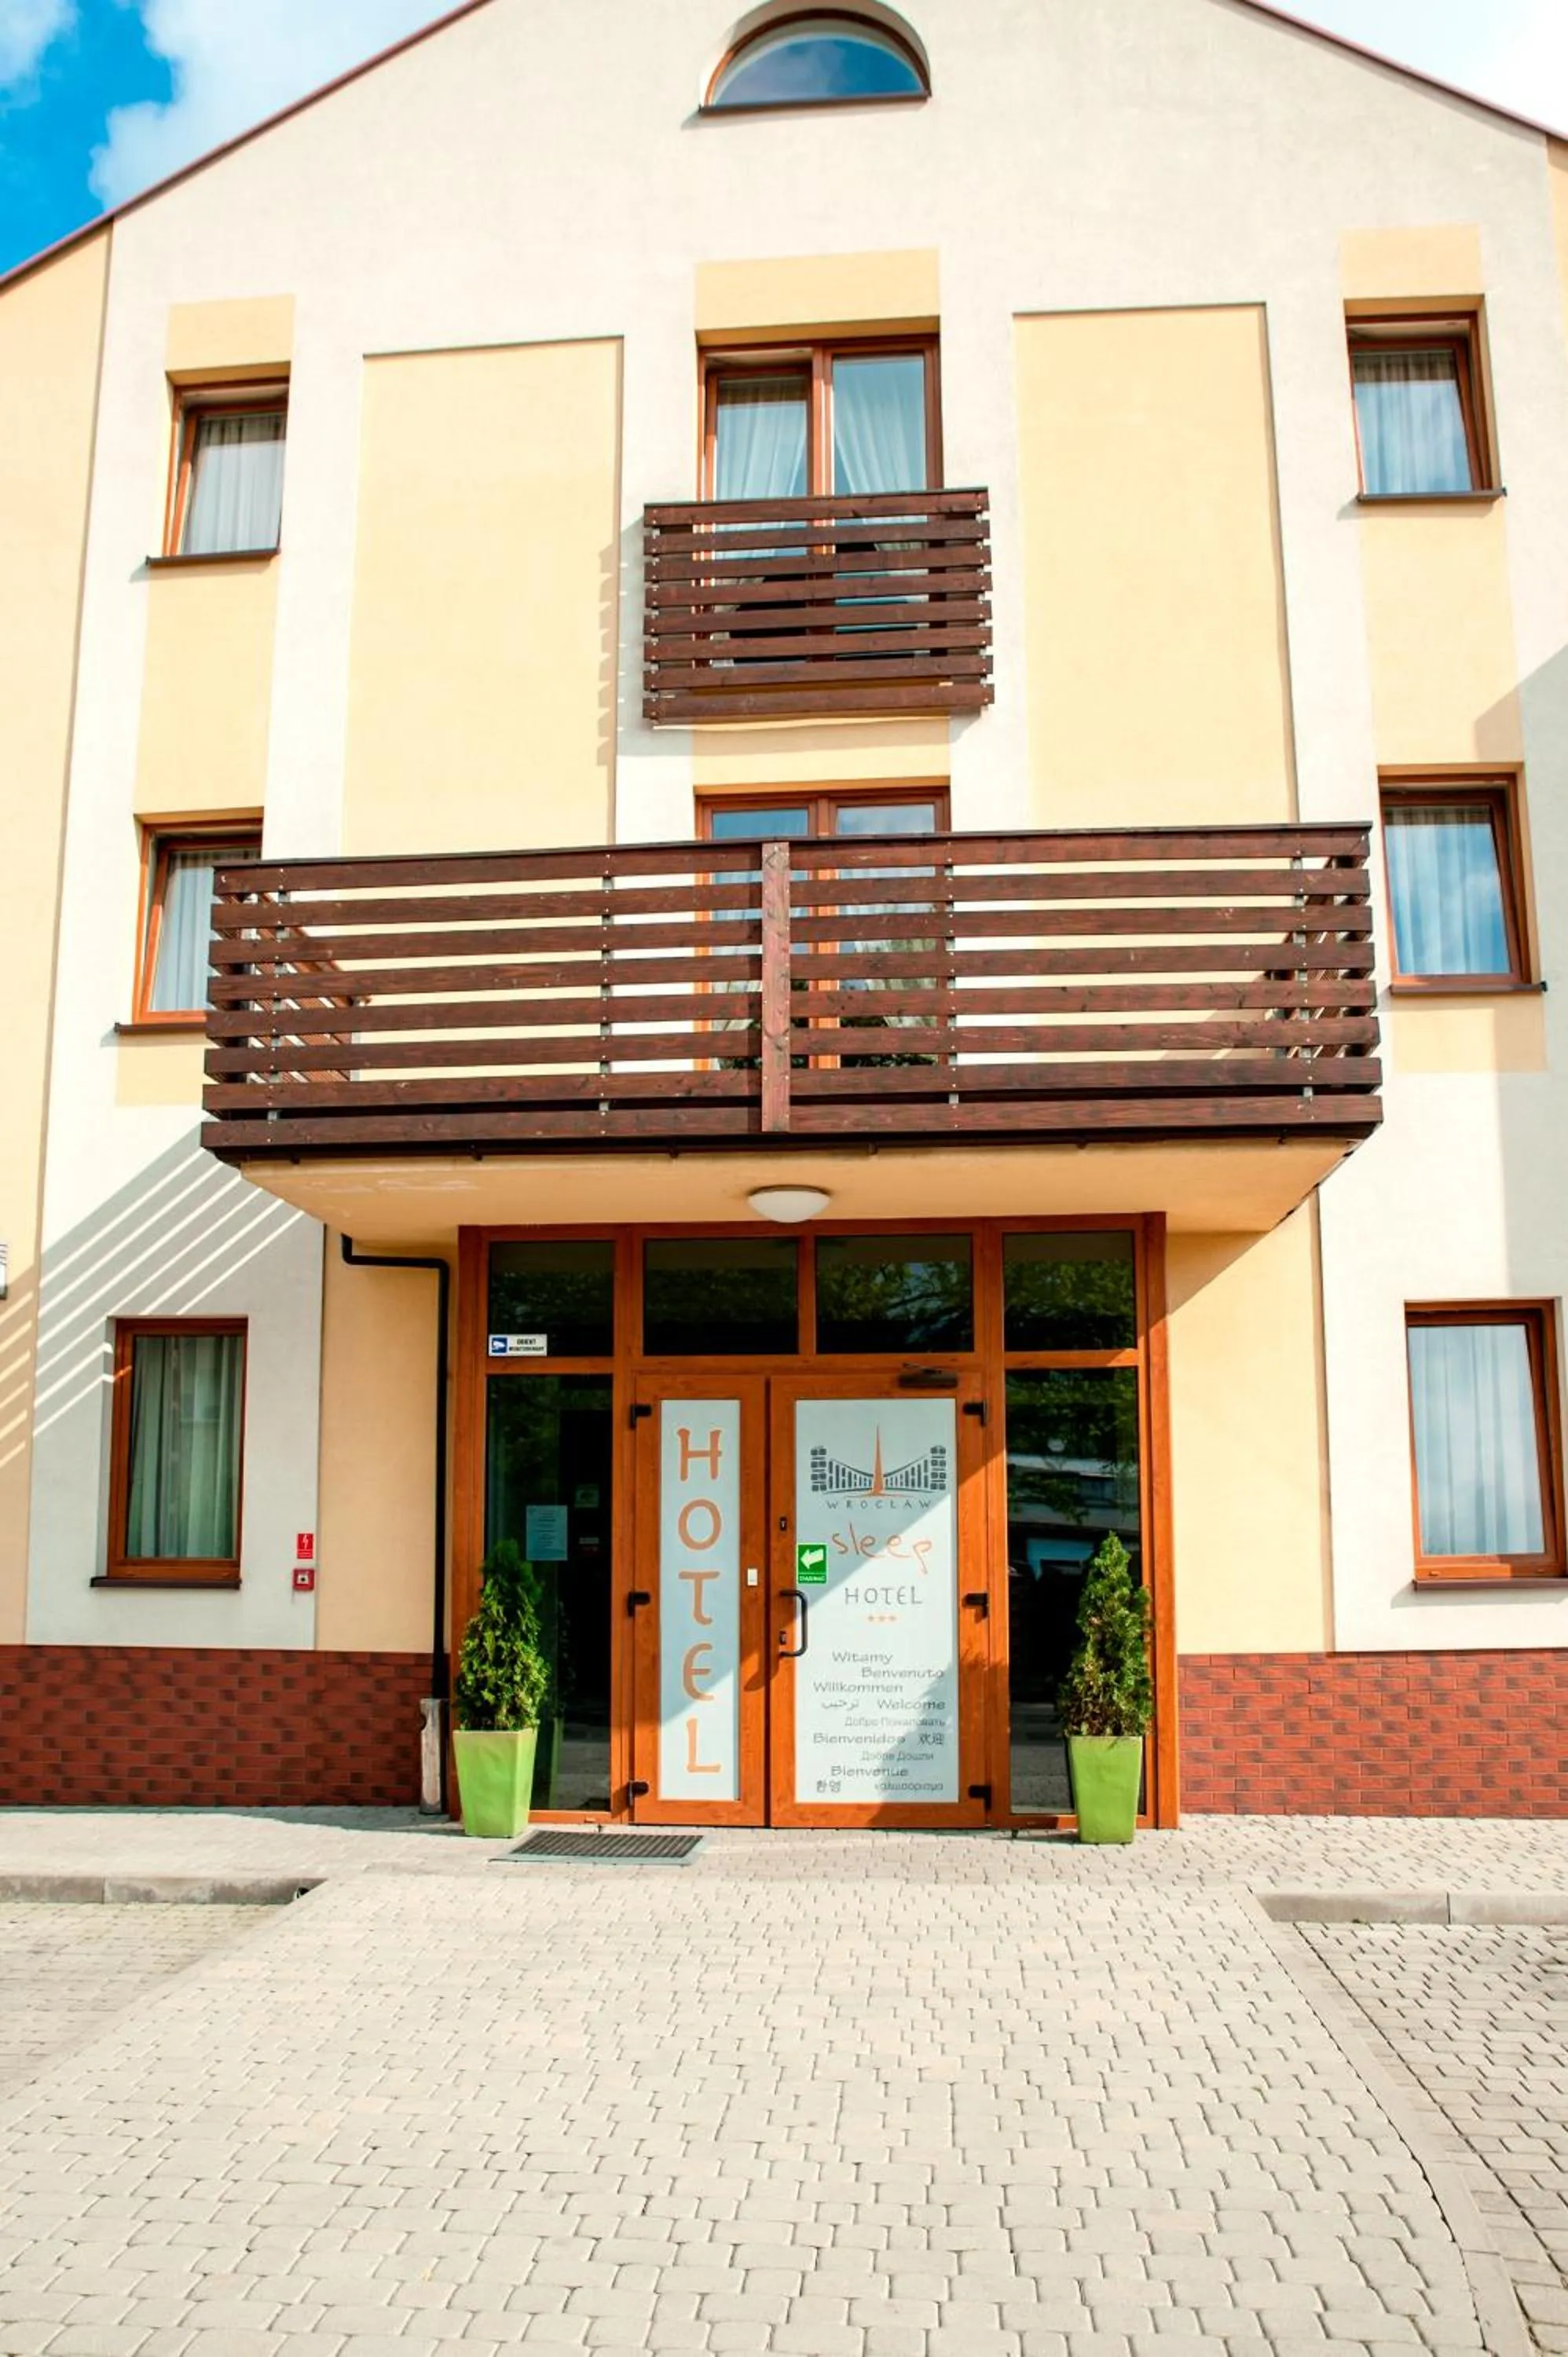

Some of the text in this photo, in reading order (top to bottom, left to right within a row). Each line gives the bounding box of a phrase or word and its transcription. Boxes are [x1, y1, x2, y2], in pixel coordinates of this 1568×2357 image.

[831, 1522, 932, 1575] sleep
[676, 1427, 723, 1773] HOTEL
[844, 1585, 923, 1605] HOTEL
[832, 1651, 893, 1665] Witamy
[861, 1666, 946, 1678] Benvenuto
[813, 1681, 903, 1693] Willkommen
[877, 1699, 946, 1710] Welcome
[813, 1732, 906, 1744] Bienvenidos
[831, 1765, 909, 1776] Bienvenue
